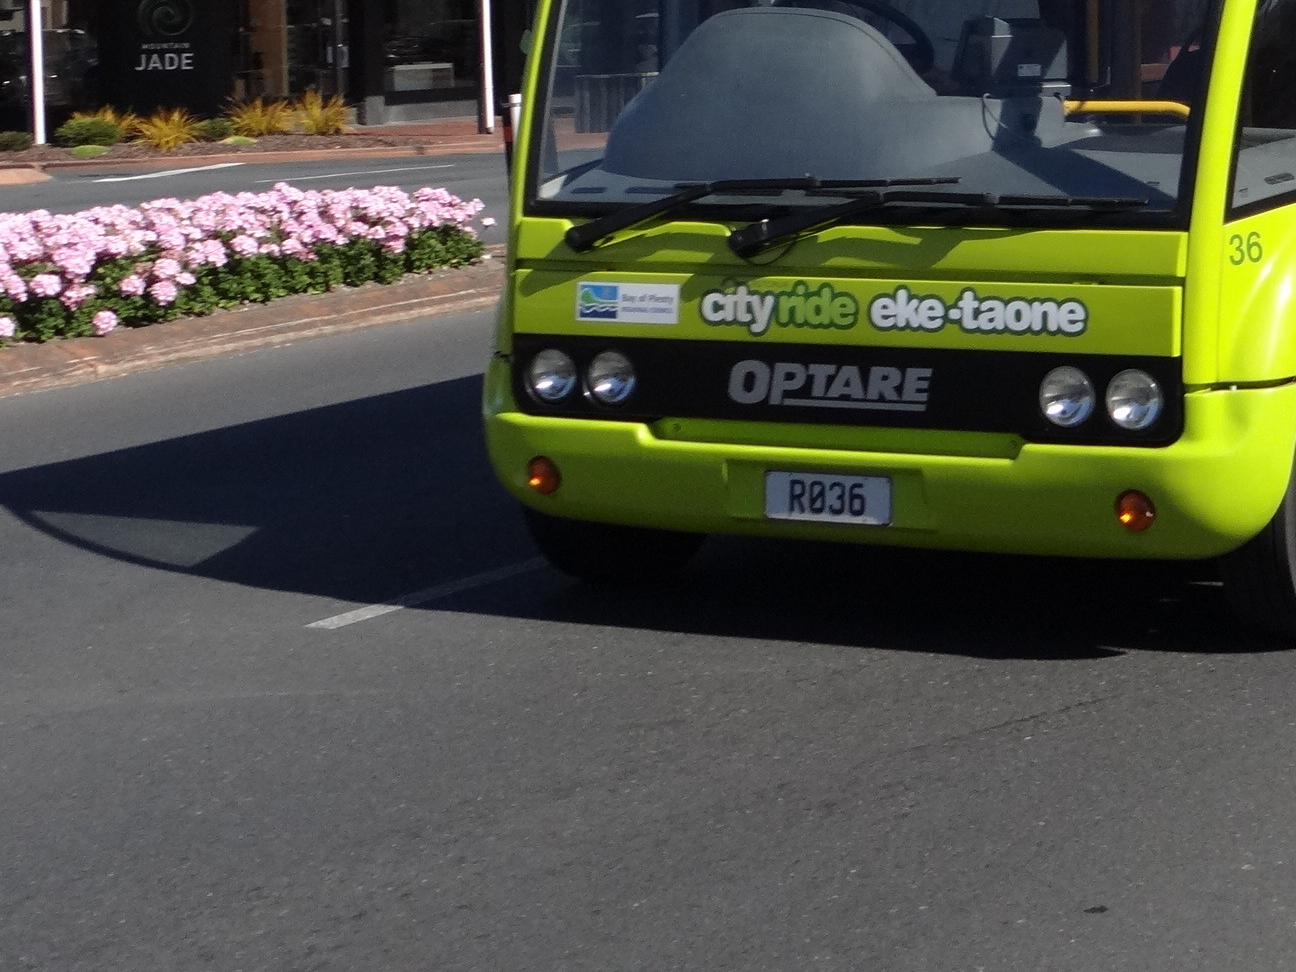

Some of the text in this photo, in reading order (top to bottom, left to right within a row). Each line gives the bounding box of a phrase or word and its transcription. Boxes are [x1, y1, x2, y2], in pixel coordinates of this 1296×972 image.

[135, 53, 195, 70] JADE
[1229, 231, 1263, 265] 36
[727, 359, 934, 407] OPTARE
[788, 479, 866, 517] R036
